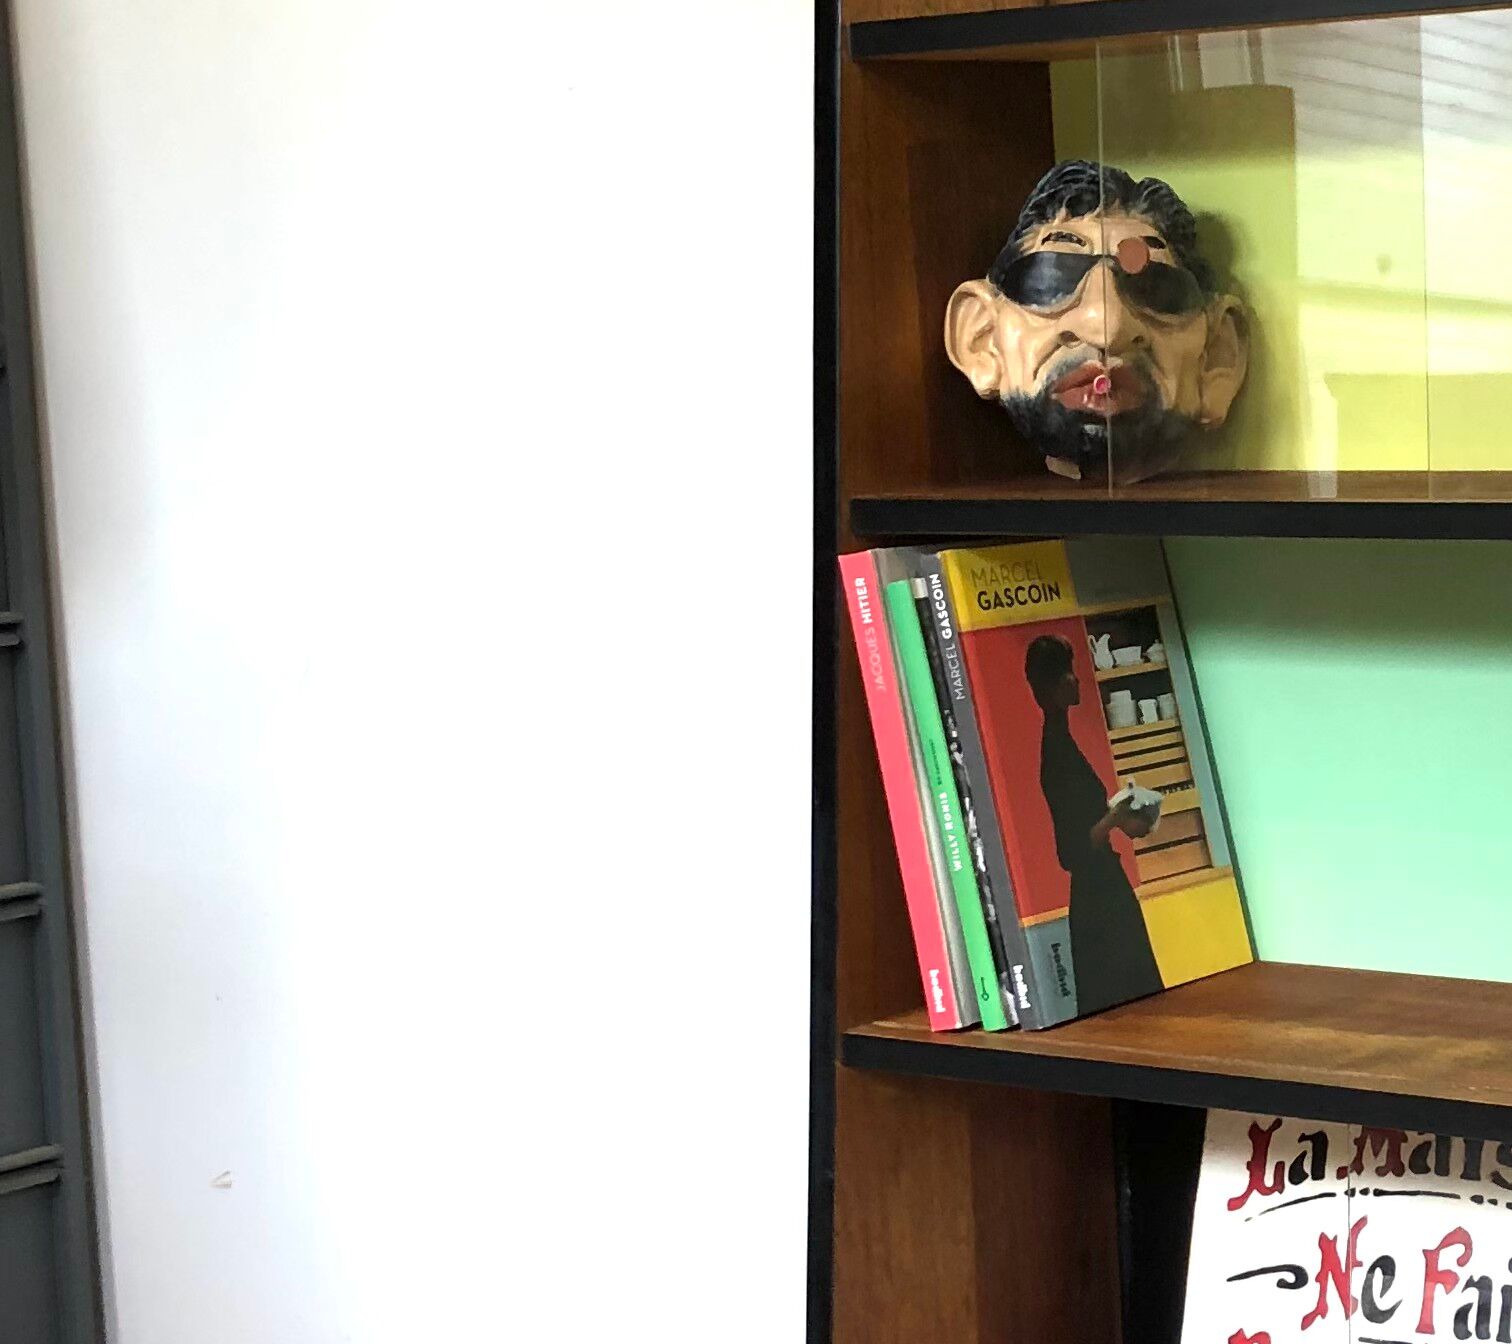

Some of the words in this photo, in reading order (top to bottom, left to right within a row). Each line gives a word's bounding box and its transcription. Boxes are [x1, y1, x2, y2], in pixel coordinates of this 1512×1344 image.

[854, 577, 873, 624] HITIER
[970, 559, 1042, 587] MARCEL
[977, 582, 1061, 610] GASCOIN
[929, 573, 953, 639] GASCOIN
[864, 627, 886, 692] JACQUES
[945, 643, 966, 700] MARCEL
[1227, 1118, 1328, 1211] La
[1301, 1216, 1403, 1330] Ne
